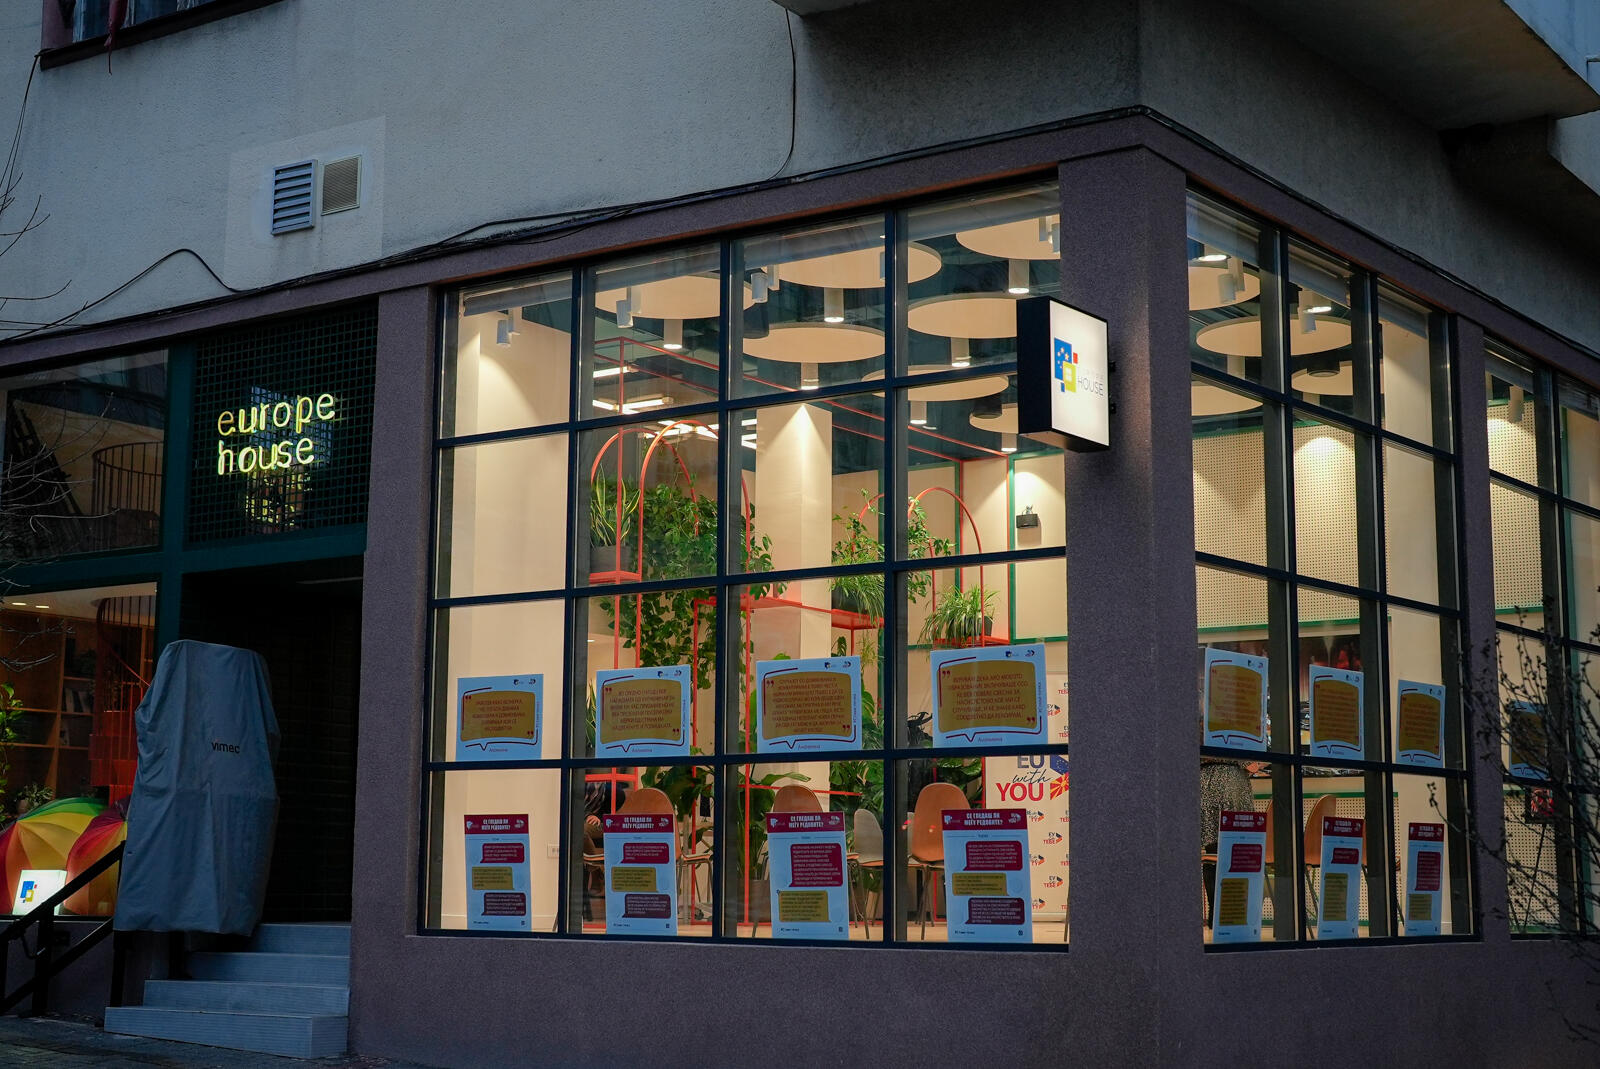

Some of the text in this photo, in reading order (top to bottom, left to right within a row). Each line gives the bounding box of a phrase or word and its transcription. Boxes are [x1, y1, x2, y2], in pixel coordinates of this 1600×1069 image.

[1078, 376, 1104, 396] HOUSE
[218, 393, 335, 436] europe
[218, 437, 315, 475] house
[211, 740, 240, 754] vimec
[1017, 754, 1045, 769] EU
[1012, 769, 1052, 784] with
[996, 783, 1044, 801] YOU
